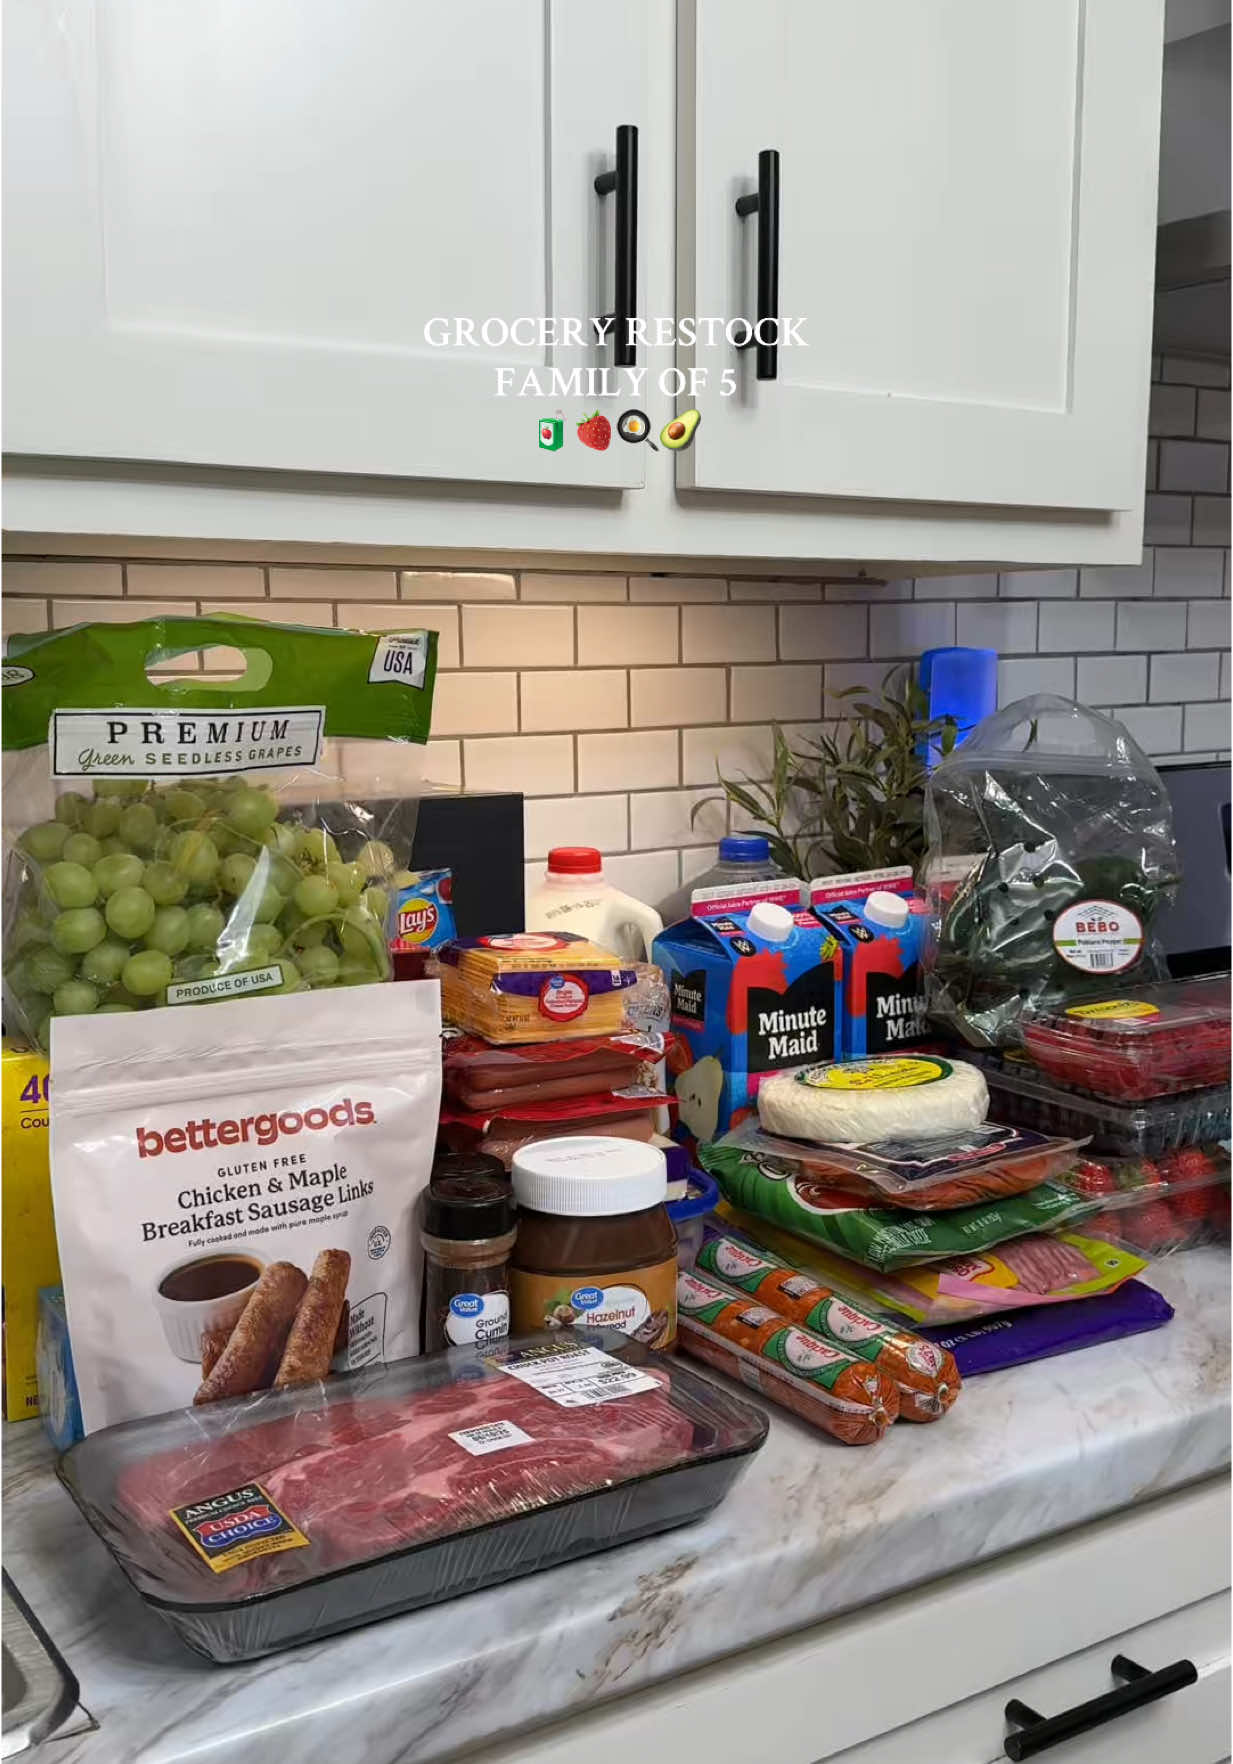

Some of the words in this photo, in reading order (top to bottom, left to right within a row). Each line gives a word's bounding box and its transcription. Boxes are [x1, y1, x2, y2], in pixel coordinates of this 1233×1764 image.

[384, 649, 413, 675] USA
[107, 719, 291, 744] PREMIUM
[78, 748, 135, 771] Green
[146, 749, 243, 766] SEEDLESS
[248, 746, 302, 761] GRAPES
[400, 906, 435, 935] Lay's
[1076, 921, 1120, 933] BEBO
[176, 981, 231, 998] PRODUCE
[234, 977, 248, 988] OF
[251, 972, 273, 984] USA
[674, 983, 702, 1001] Minute
[677, 997, 697, 1014] Maid
[876, 993, 925, 1019] Minu
[758, 1005, 827, 1035] Minute
[768, 1030, 819, 1060] Maid
[20, 1116, 49, 1130] Cou
[136, 1098, 375, 1158] bettergoods
[217, 1160, 268, 1178] GLUTEN
[274, 1153, 307, 1169] FREE
[178, 1181, 262, 1209] Chicken
[267, 1177, 284, 1193] &
[288, 1163, 348, 1190] Maple
[142, 1208, 244, 1241] Breakfast
[248, 1193, 335, 1222] Sausage
[338, 1180, 375, 1204] Links
[188, 1237, 205, 1248] Fully
[207, 1232, 233, 1244] cooked
[233, 1229, 247, 1240] and
[248, 1226, 269, 1236] made
[271, 1221, 288, 1232] with
[289, 1219, 307, 1230] pure
[308, 1213, 331, 1225] maple
[454, 1298, 479, 1309] Great
[575, 1291, 598, 1302] Great
[476, 1312, 508, 1328] Ground
[586, 1307, 636, 1324] Hazelnut
[838, 1305, 882, 1331] Cacique
[475, 1322, 508, 1340] Cumin
[796, 1335, 841, 1358] Cacique
[185, 1488, 255, 1519] ANGUS
[208, 1515, 277, 1543] CHOICE
[210, 1510, 263, 1532] USDA
